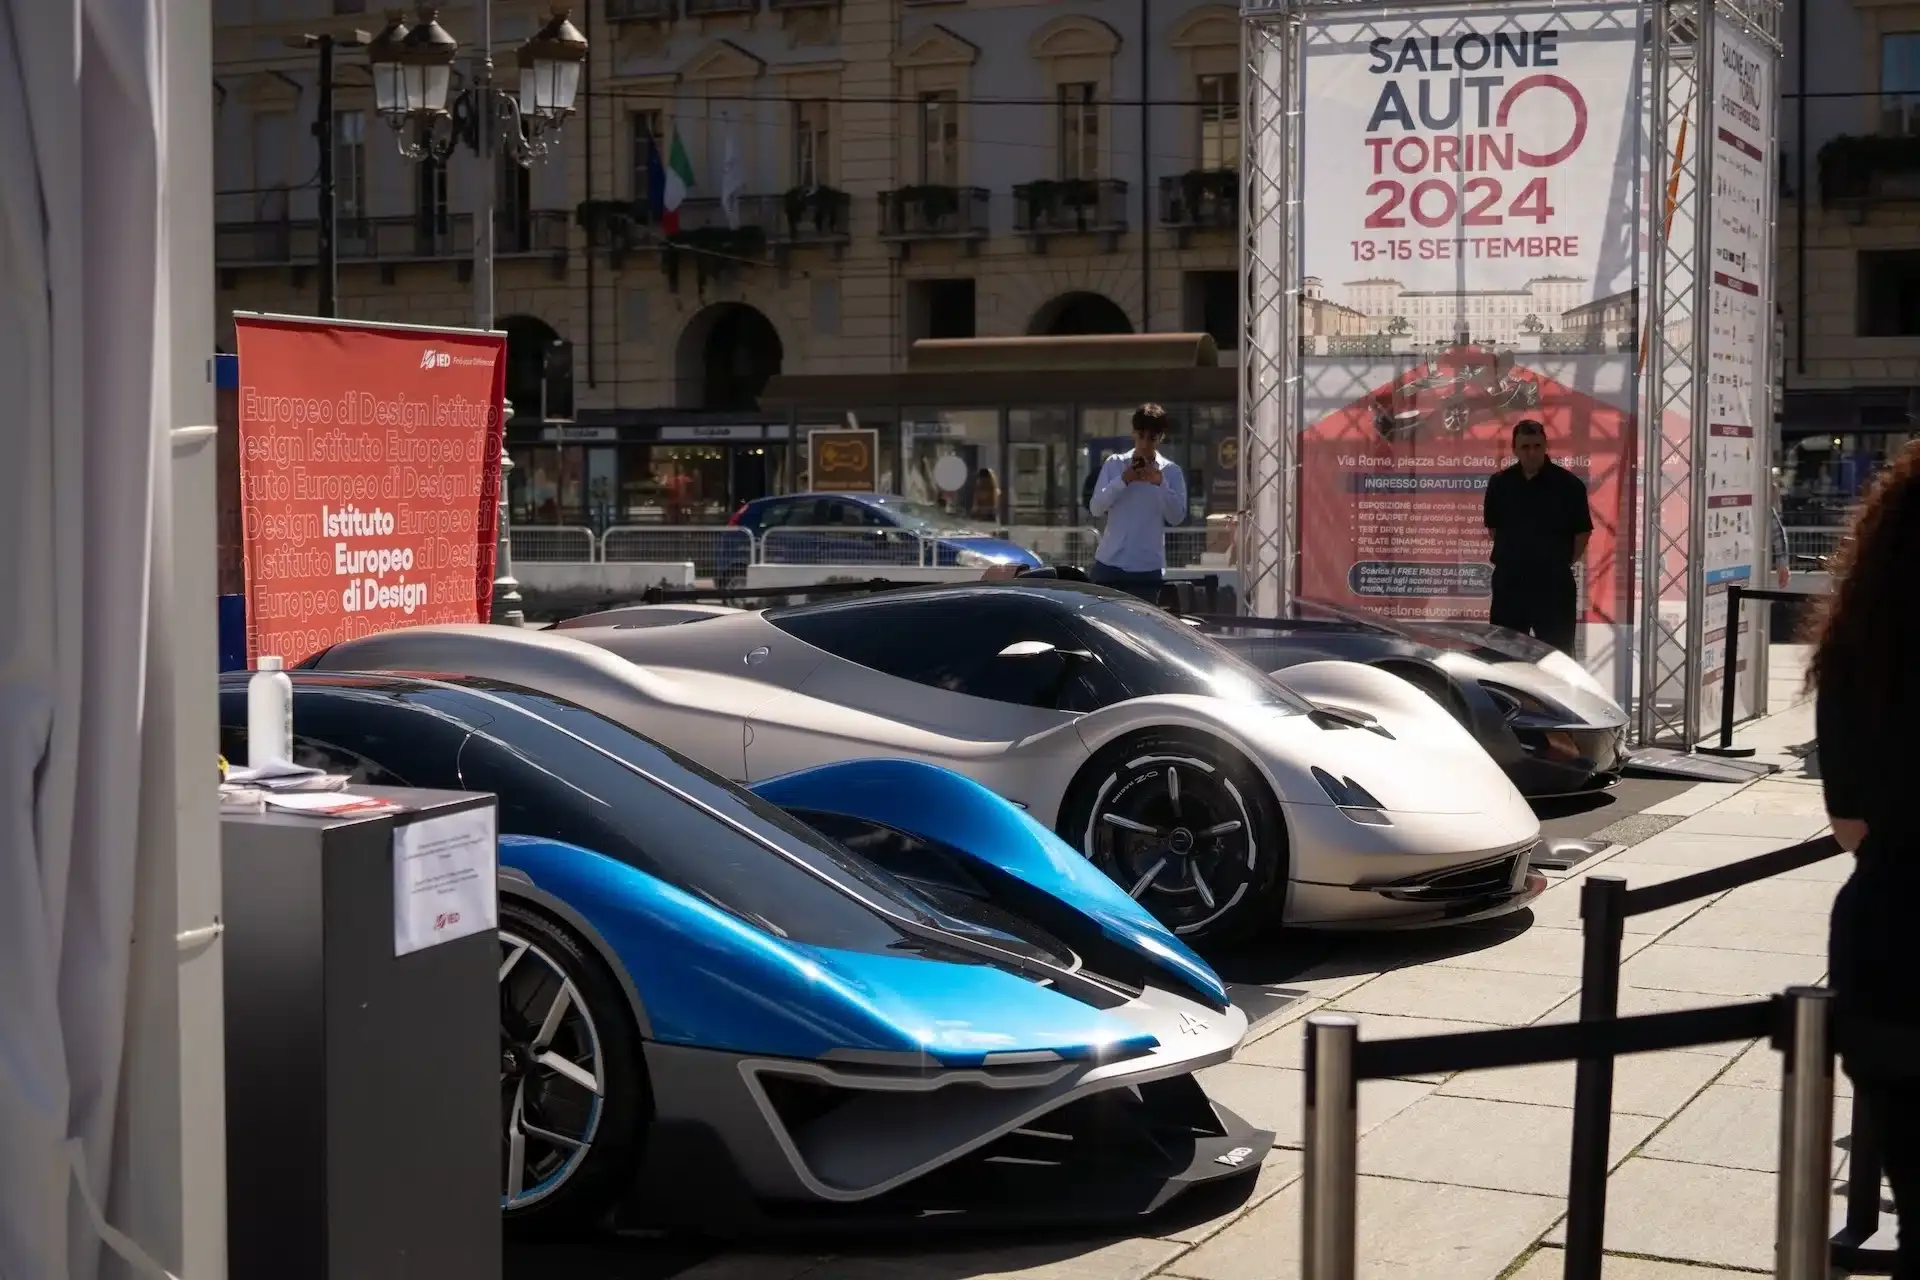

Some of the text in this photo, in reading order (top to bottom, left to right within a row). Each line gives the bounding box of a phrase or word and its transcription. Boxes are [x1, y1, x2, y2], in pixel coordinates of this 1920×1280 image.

[1368, 30, 1559, 73] SALONE
[1365, 74, 1588, 167] AUTO
[1364, 177, 1555, 229] 2024
[1351, 236, 1579, 262] 13-15 SETTEMBRE
[436, 354, 451, 368] IED
[242, 386, 498, 434] Europeo di Design Istituto
[307, 427, 383, 462] Istituto
[386, 429, 464, 468] Europeo
[466, 429, 484, 462] di
[1337, 455, 1355, 467] Via
[1358, 455, 1395, 468] Roma,
[1398, 455, 1434, 470] piazza
[1437, 455, 1460, 467] San
[1463, 455, 1497, 468] Carlo,
[293, 466, 379, 506] Europeo
[382, 465, 400, 499] di
[403, 465, 467, 505] Design
[1364, 478, 1416, 489] INGRESSO
[1420, 478, 1471, 489] GRATUITO
[1358, 501, 1411, 510] ESPOSIZIONE
[1358, 512, 1374, 521] RED
[1376, 512, 1408, 521] CARPET
[243, 499, 491, 547] Design Istituto Europeo di
[1359, 525, 1378, 534] TEST
[1380, 525, 1404, 534] DRIVE
[1358, 537, 1389, 546] SFILATE
[1391, 538, 1436, 547] DINAMICHE
[255, 535, 496, 580] Istituto Europeo di Design
[1360, 565, 1389, 576] Scarica
[1397, 567, 1418, 576] FREE
[1419, 567, 1441, 577] PASS
[1442, 568, 1476, 577] SALONE
[1366, 576, 1392, 584] accedi
[1409, 576, 1432, 585] sconti
[254, 570, 492, 623] Europeo di Design Istituto
[1386, 585, 1406, 594] hotel
[1413, 586, 1448, 594] ristoranti
[246, 624, 331, 663] Europeo
[1111, 781, 1135, 803] RACING
